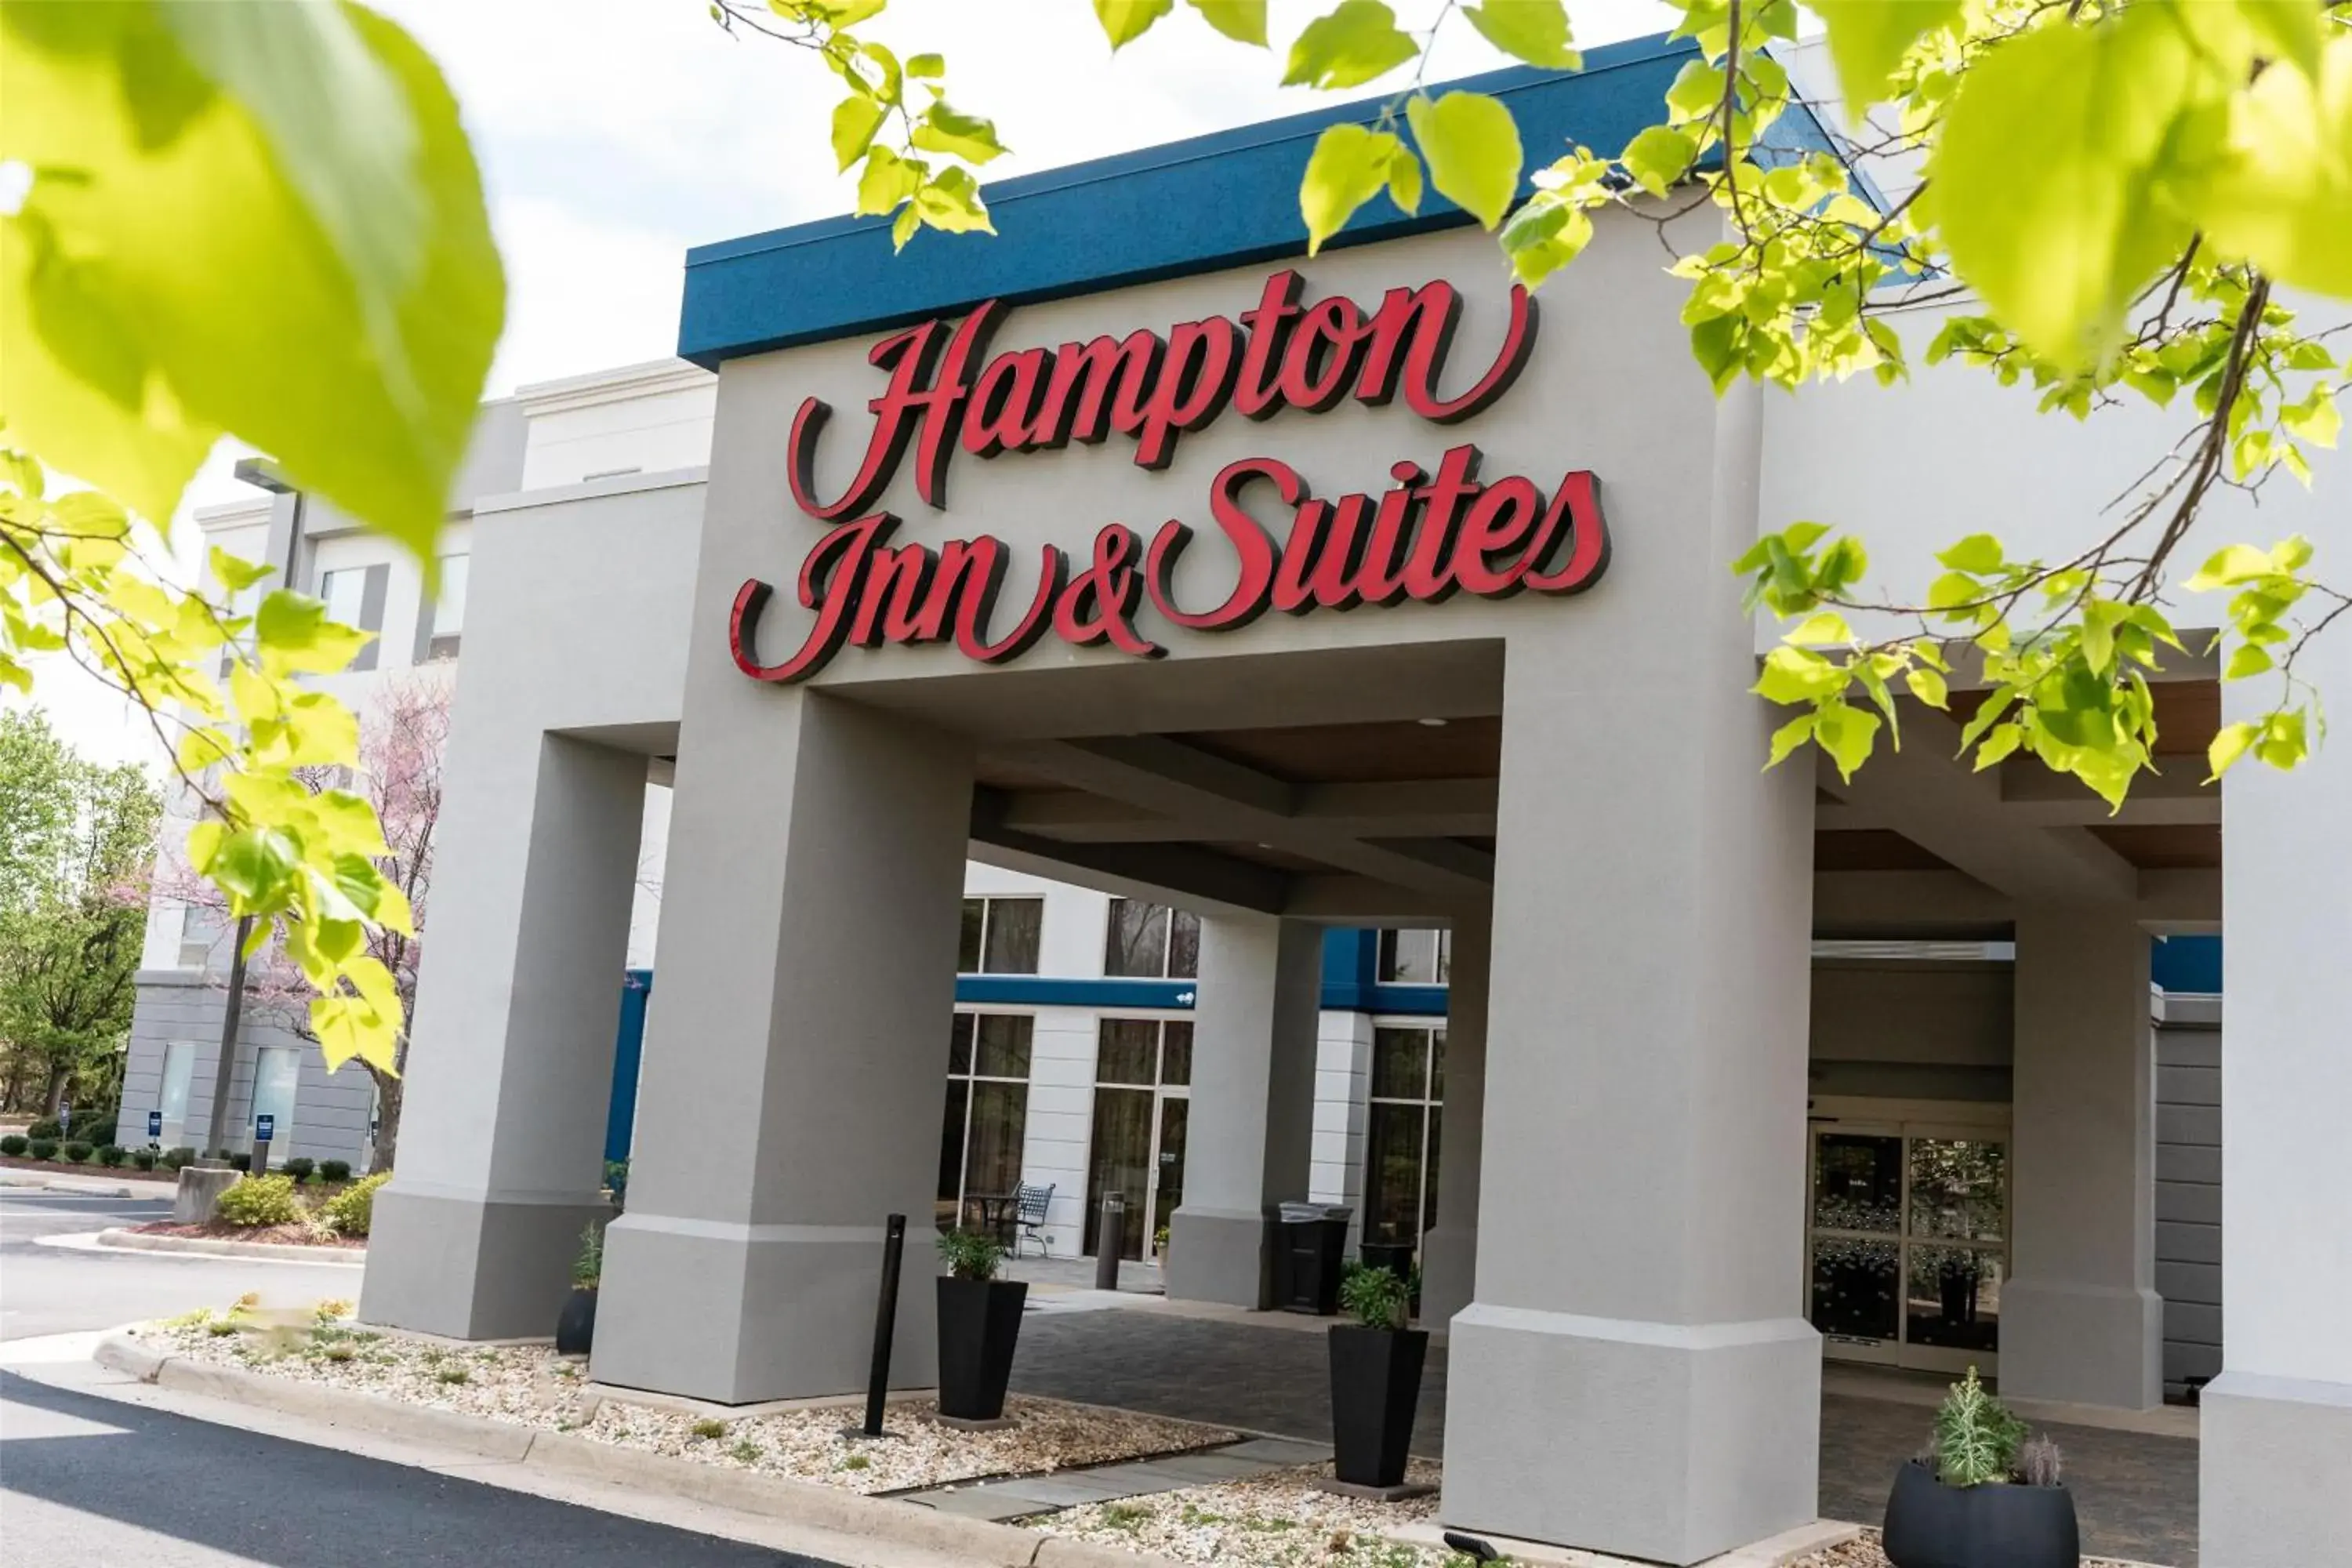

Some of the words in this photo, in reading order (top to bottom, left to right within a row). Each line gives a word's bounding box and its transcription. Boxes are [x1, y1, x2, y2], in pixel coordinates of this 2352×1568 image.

[787, 270, 1538, 521] Hampton
[731, 513, 1068, 683] Inn
[1055, 523, 1168, 659] &
[1146, 445, 1610, 631] Suites
